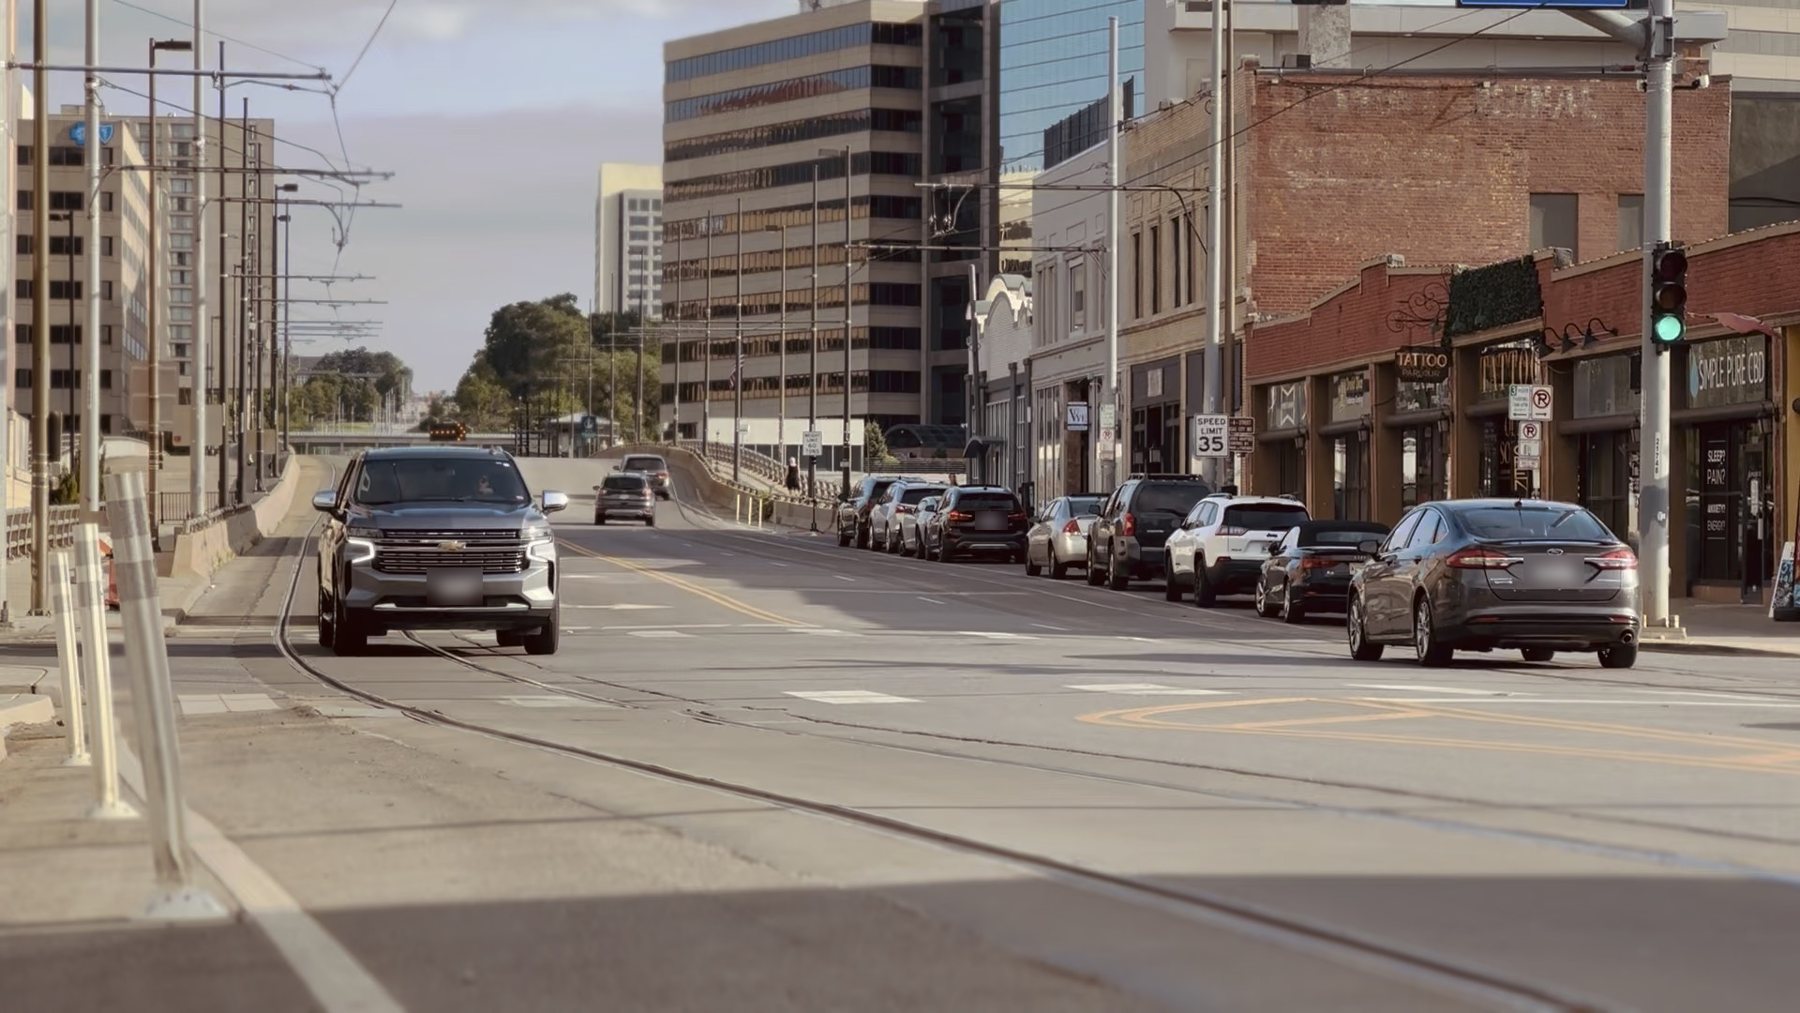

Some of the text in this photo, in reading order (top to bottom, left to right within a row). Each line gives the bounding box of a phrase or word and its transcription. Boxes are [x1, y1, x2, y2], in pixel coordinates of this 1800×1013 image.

[1396, 352, 1448, 368] TATTOO
[1698, 350, 1765, 390] SIMPLE PURE CBD
[1198, 417, 1226, 426] SPEED
[1201, 427, 1223, 435] LIMIT
[1199, 436, 1224, 452] 35
[1707, 468, 1726, 485] PAIN?
